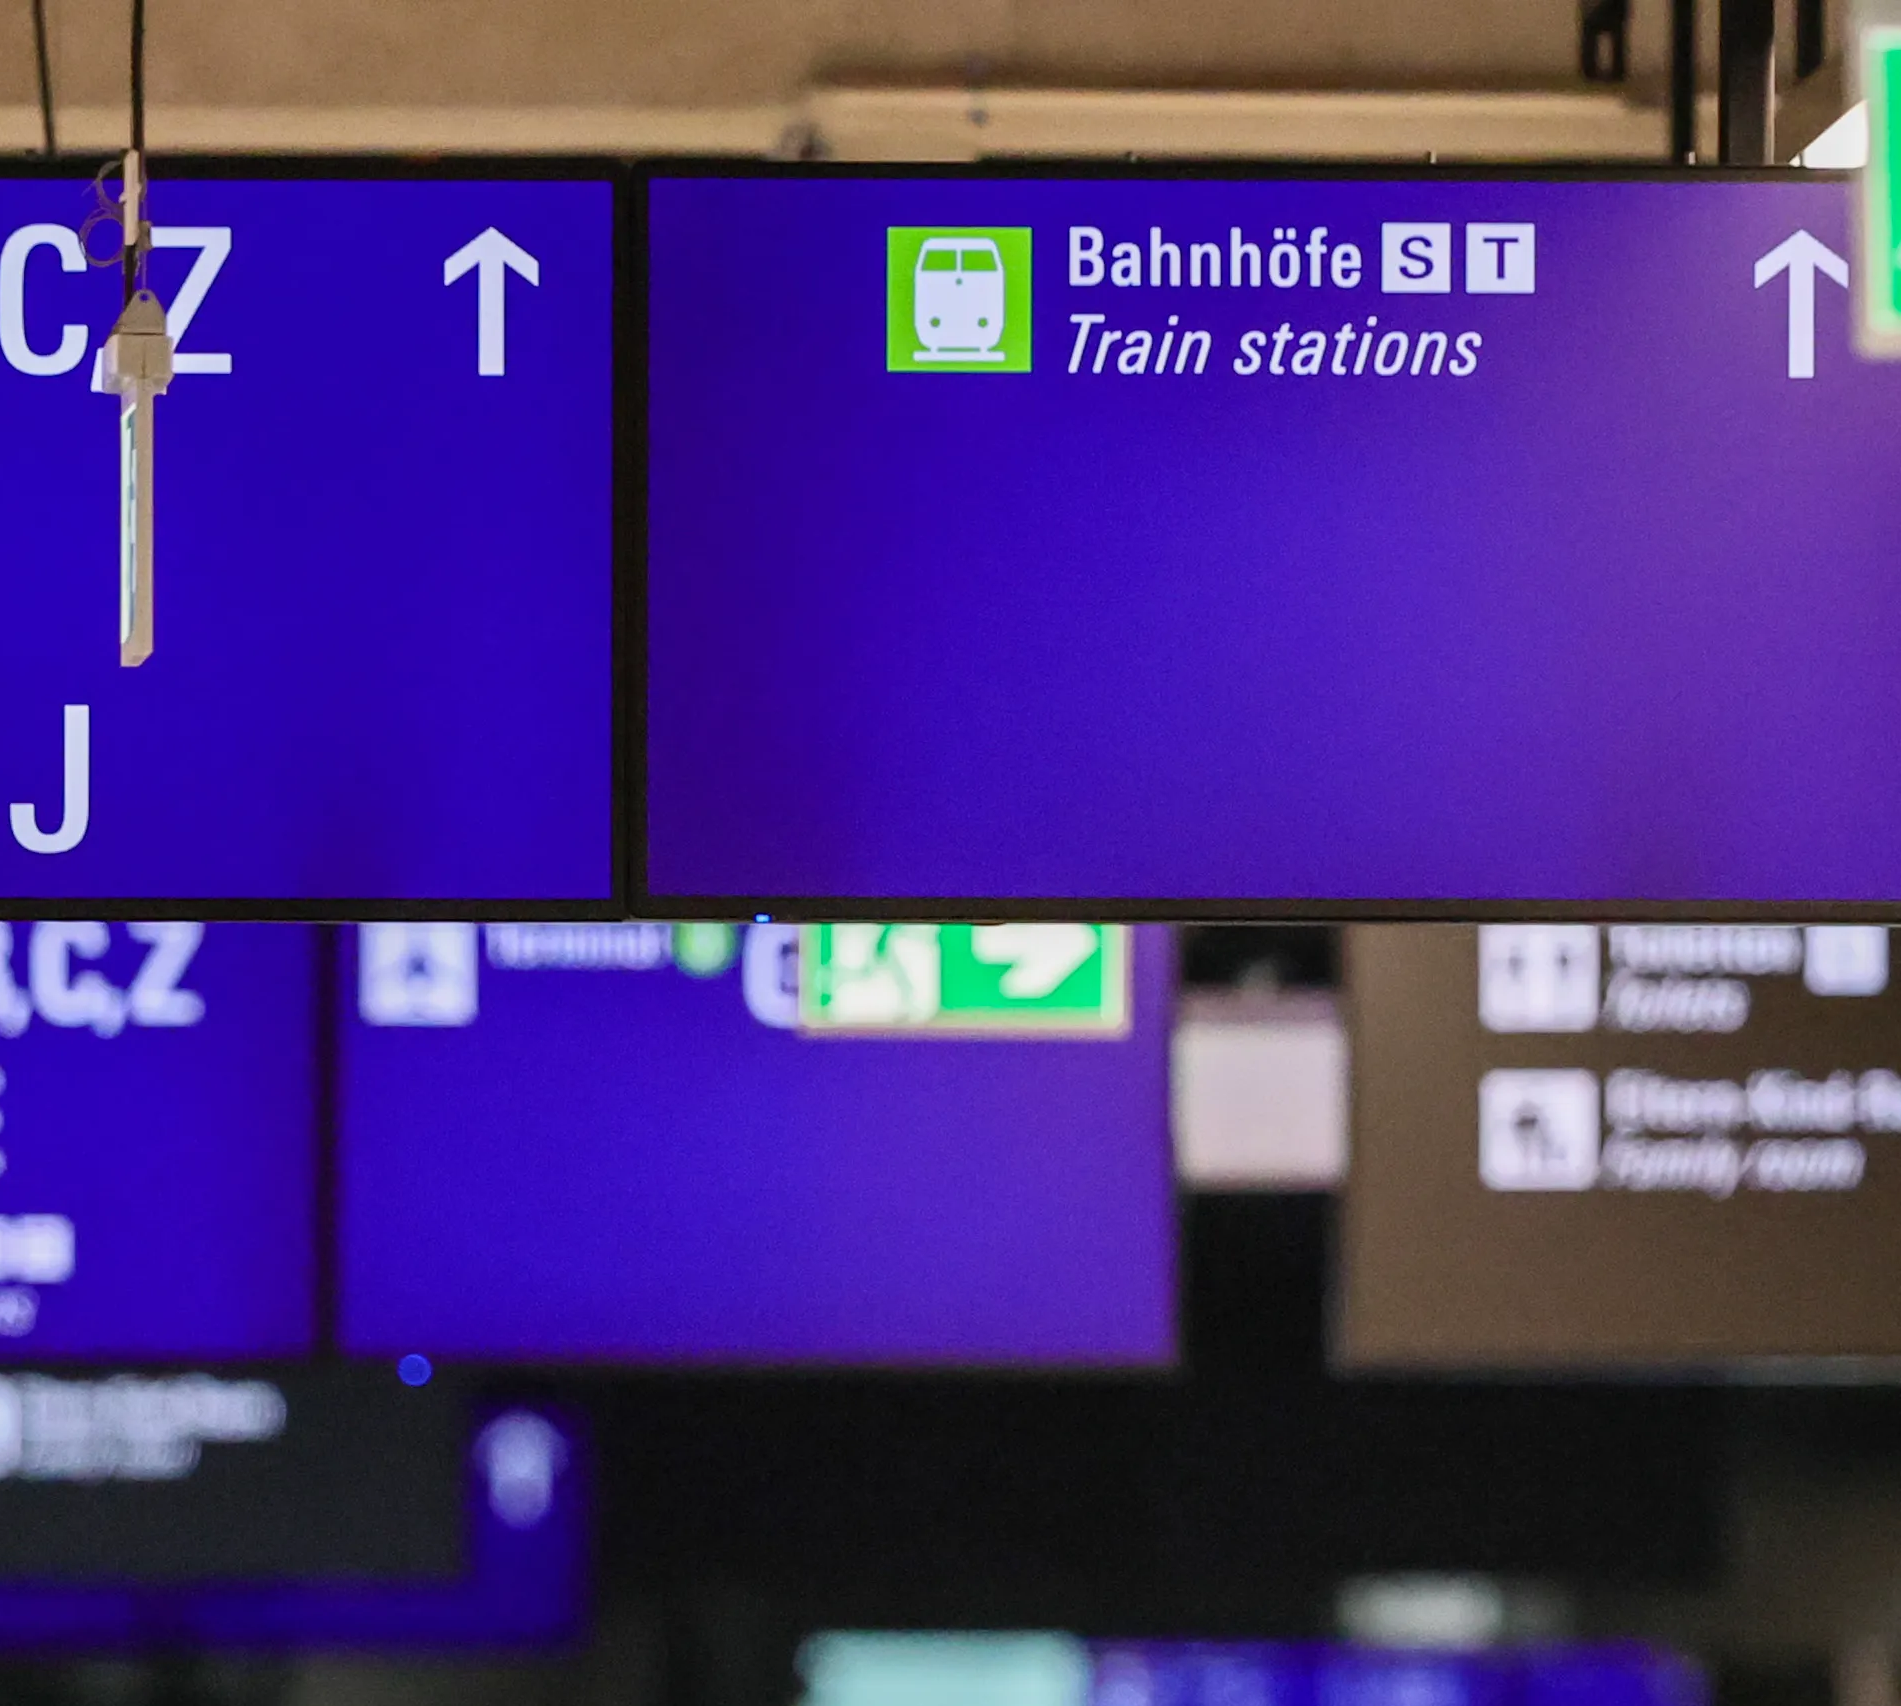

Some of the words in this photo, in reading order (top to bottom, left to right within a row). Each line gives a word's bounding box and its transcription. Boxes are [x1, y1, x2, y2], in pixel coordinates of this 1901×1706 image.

[1069, 225, 1362, 288] Bahnhöfe
[1399, 236, 1434, 280] S
[1483, 236, 1519, 279] T
[1068, 313, 1212, 375] Train
[1233, 315, 1483, 376] stations
